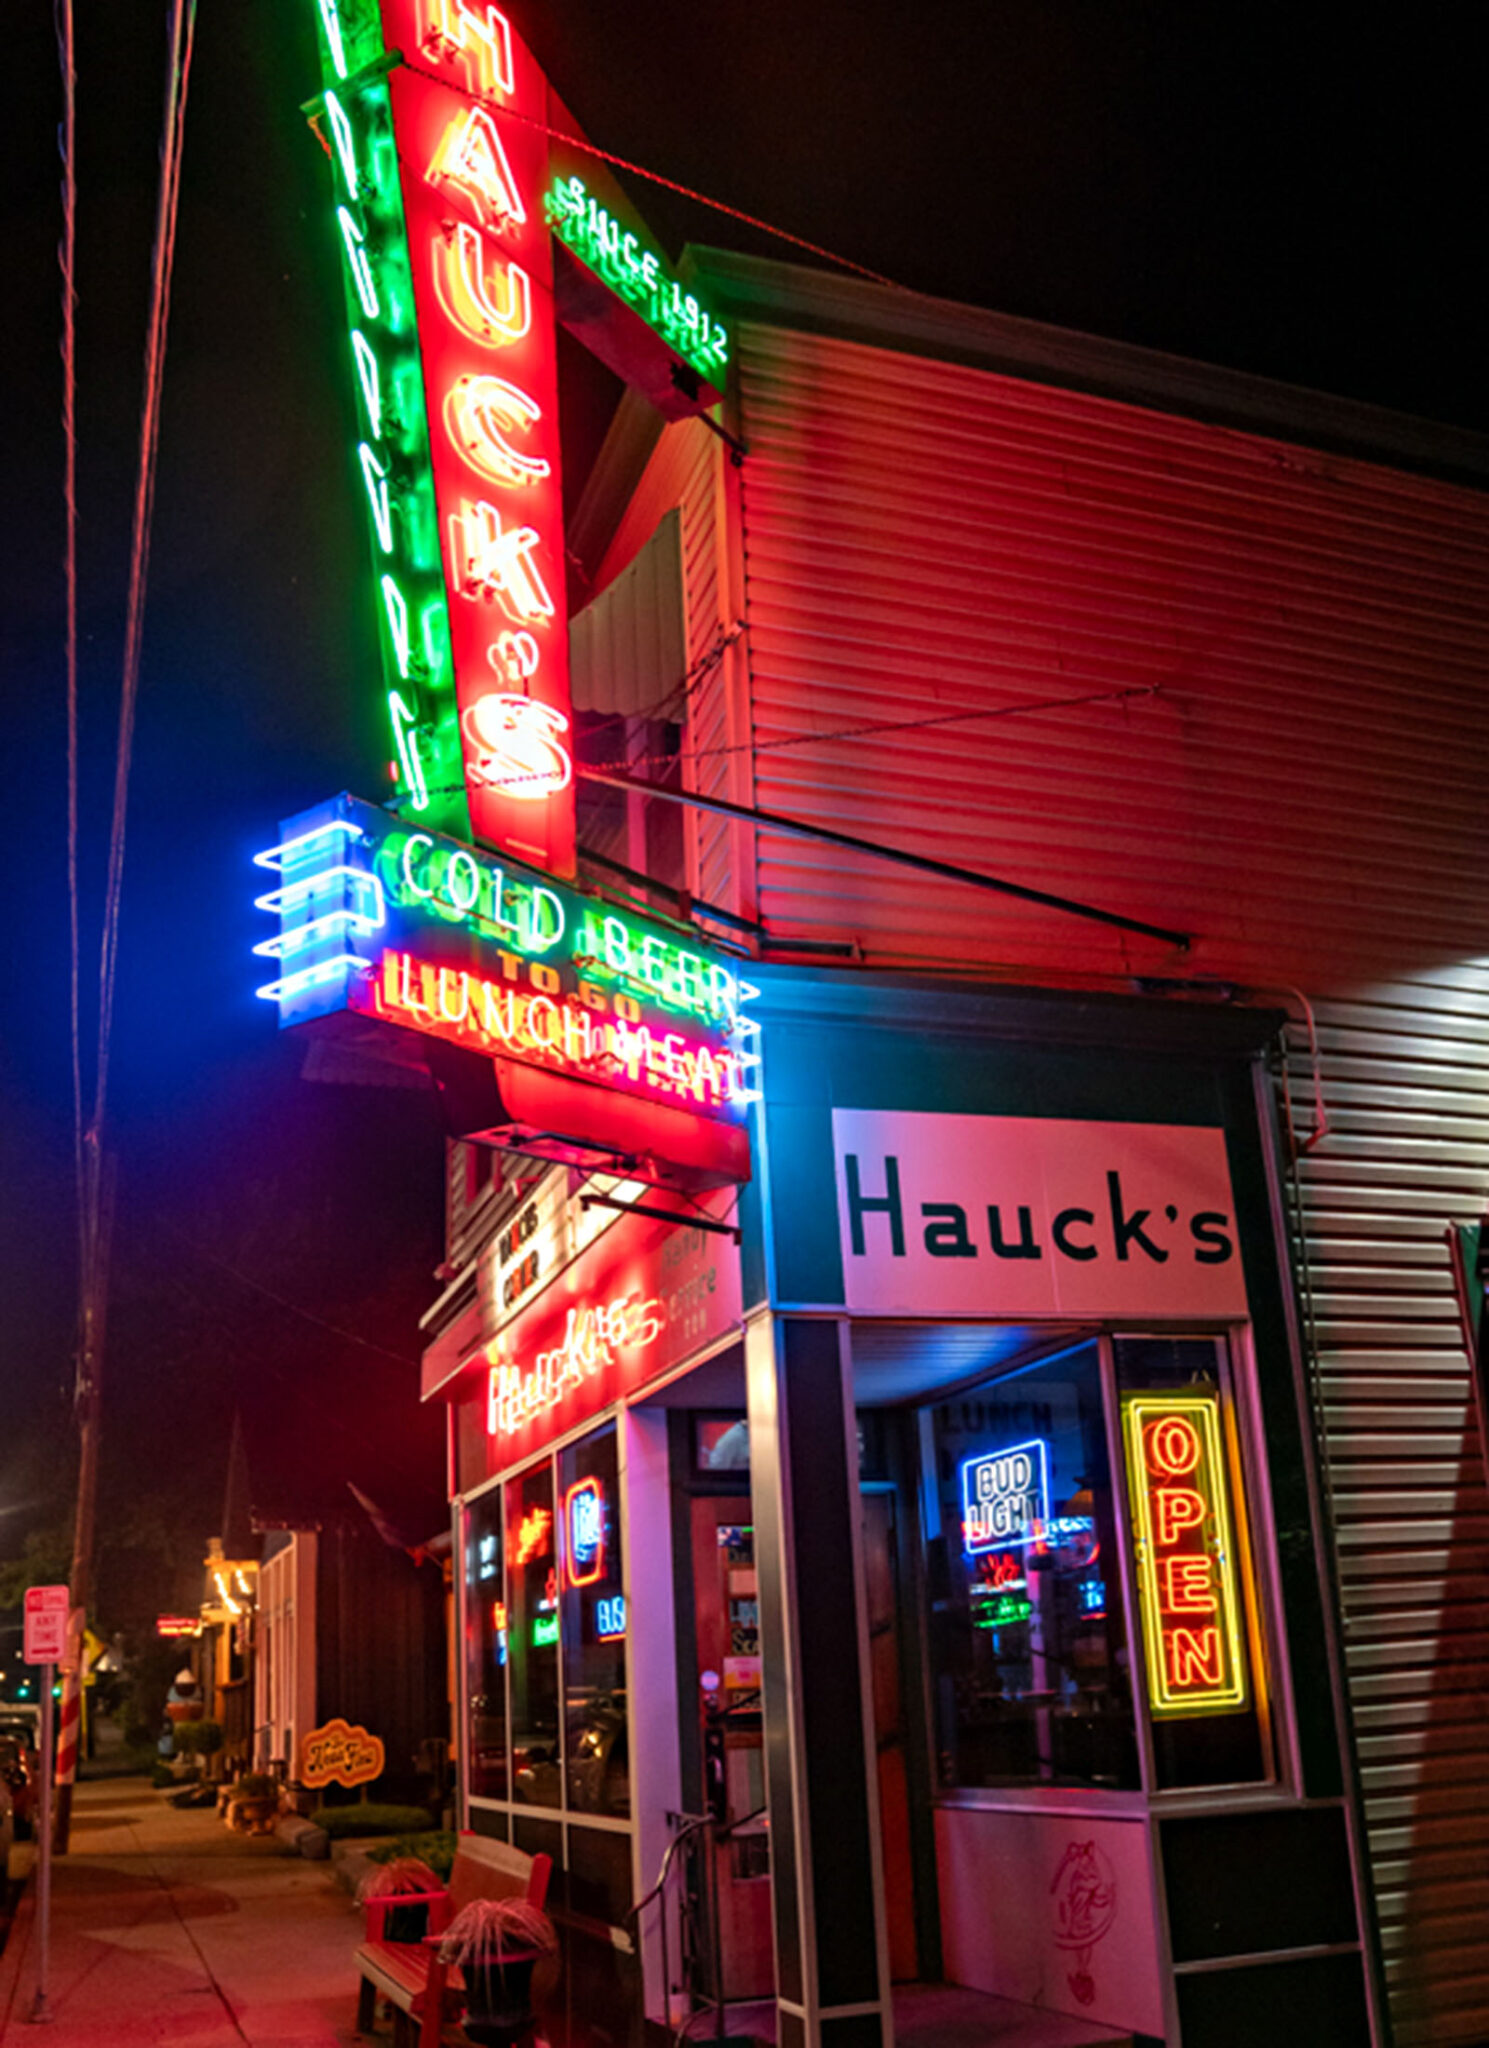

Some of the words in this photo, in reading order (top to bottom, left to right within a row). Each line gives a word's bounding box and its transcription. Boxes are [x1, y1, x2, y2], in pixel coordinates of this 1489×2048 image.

[561, 174, 660, 292] SINCE
[670, 282, 729, 364] 1912
[388, 832, 566, 950] COLD
[592, 914, 738, 1022] BEER
[497, 949, 561, 995] TO
[578, 980, 642, 1024] GO
[386, 950, 592, 1060] LUNCH
[608, 1018, 746, 1102] MEAT
[845, 1153, 1234, 1264] Hauck's
[976, 1453, 1031, 1501] BUD
[1144, 1415, 1224, 1686] OPEN
